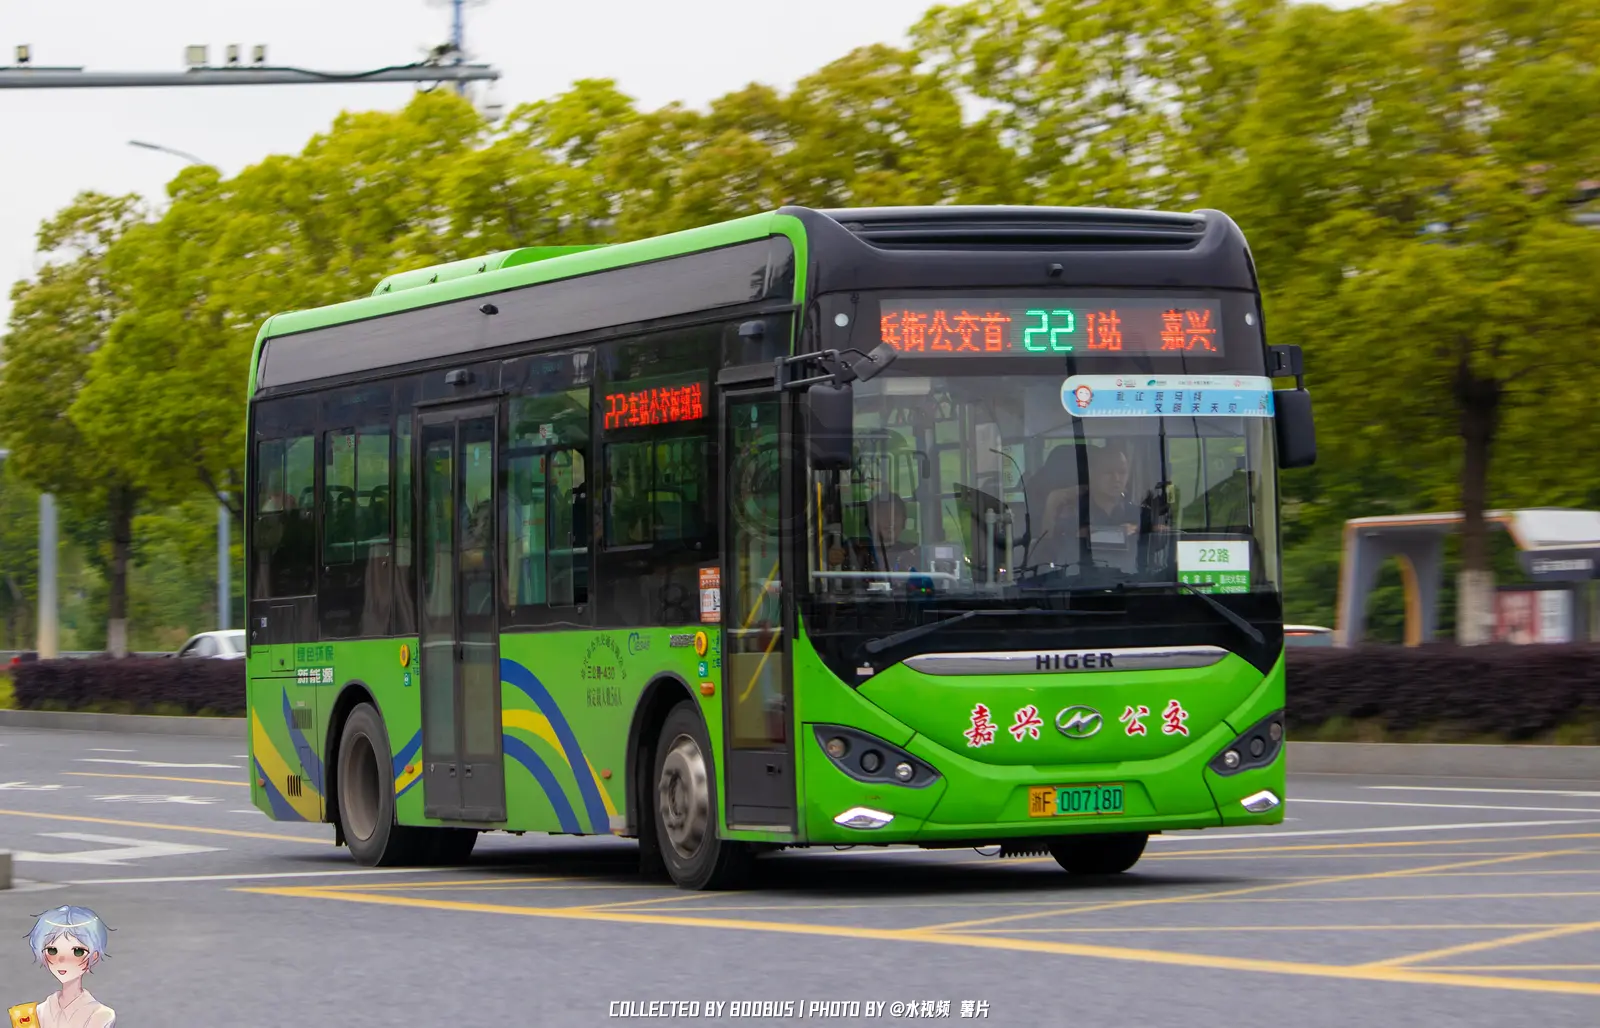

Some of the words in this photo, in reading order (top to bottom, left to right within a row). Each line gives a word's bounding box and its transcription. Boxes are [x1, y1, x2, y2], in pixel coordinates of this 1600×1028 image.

[1024, 309, 1074, 352] 22
[1199, 548, 1230, 563] 22路
[297, 645, 334, 662] 绿色环保
[1036, 652, 1113, 670] HIGER
[297, 667, 333, 684] 新能源
[963, 702, 1044, 748] 嘉兴
[1119, 698, 1189, 736] 公交
[1031, 791, 1052, 812] 浙F
[1061, 788, 1122, 812] 00718D
